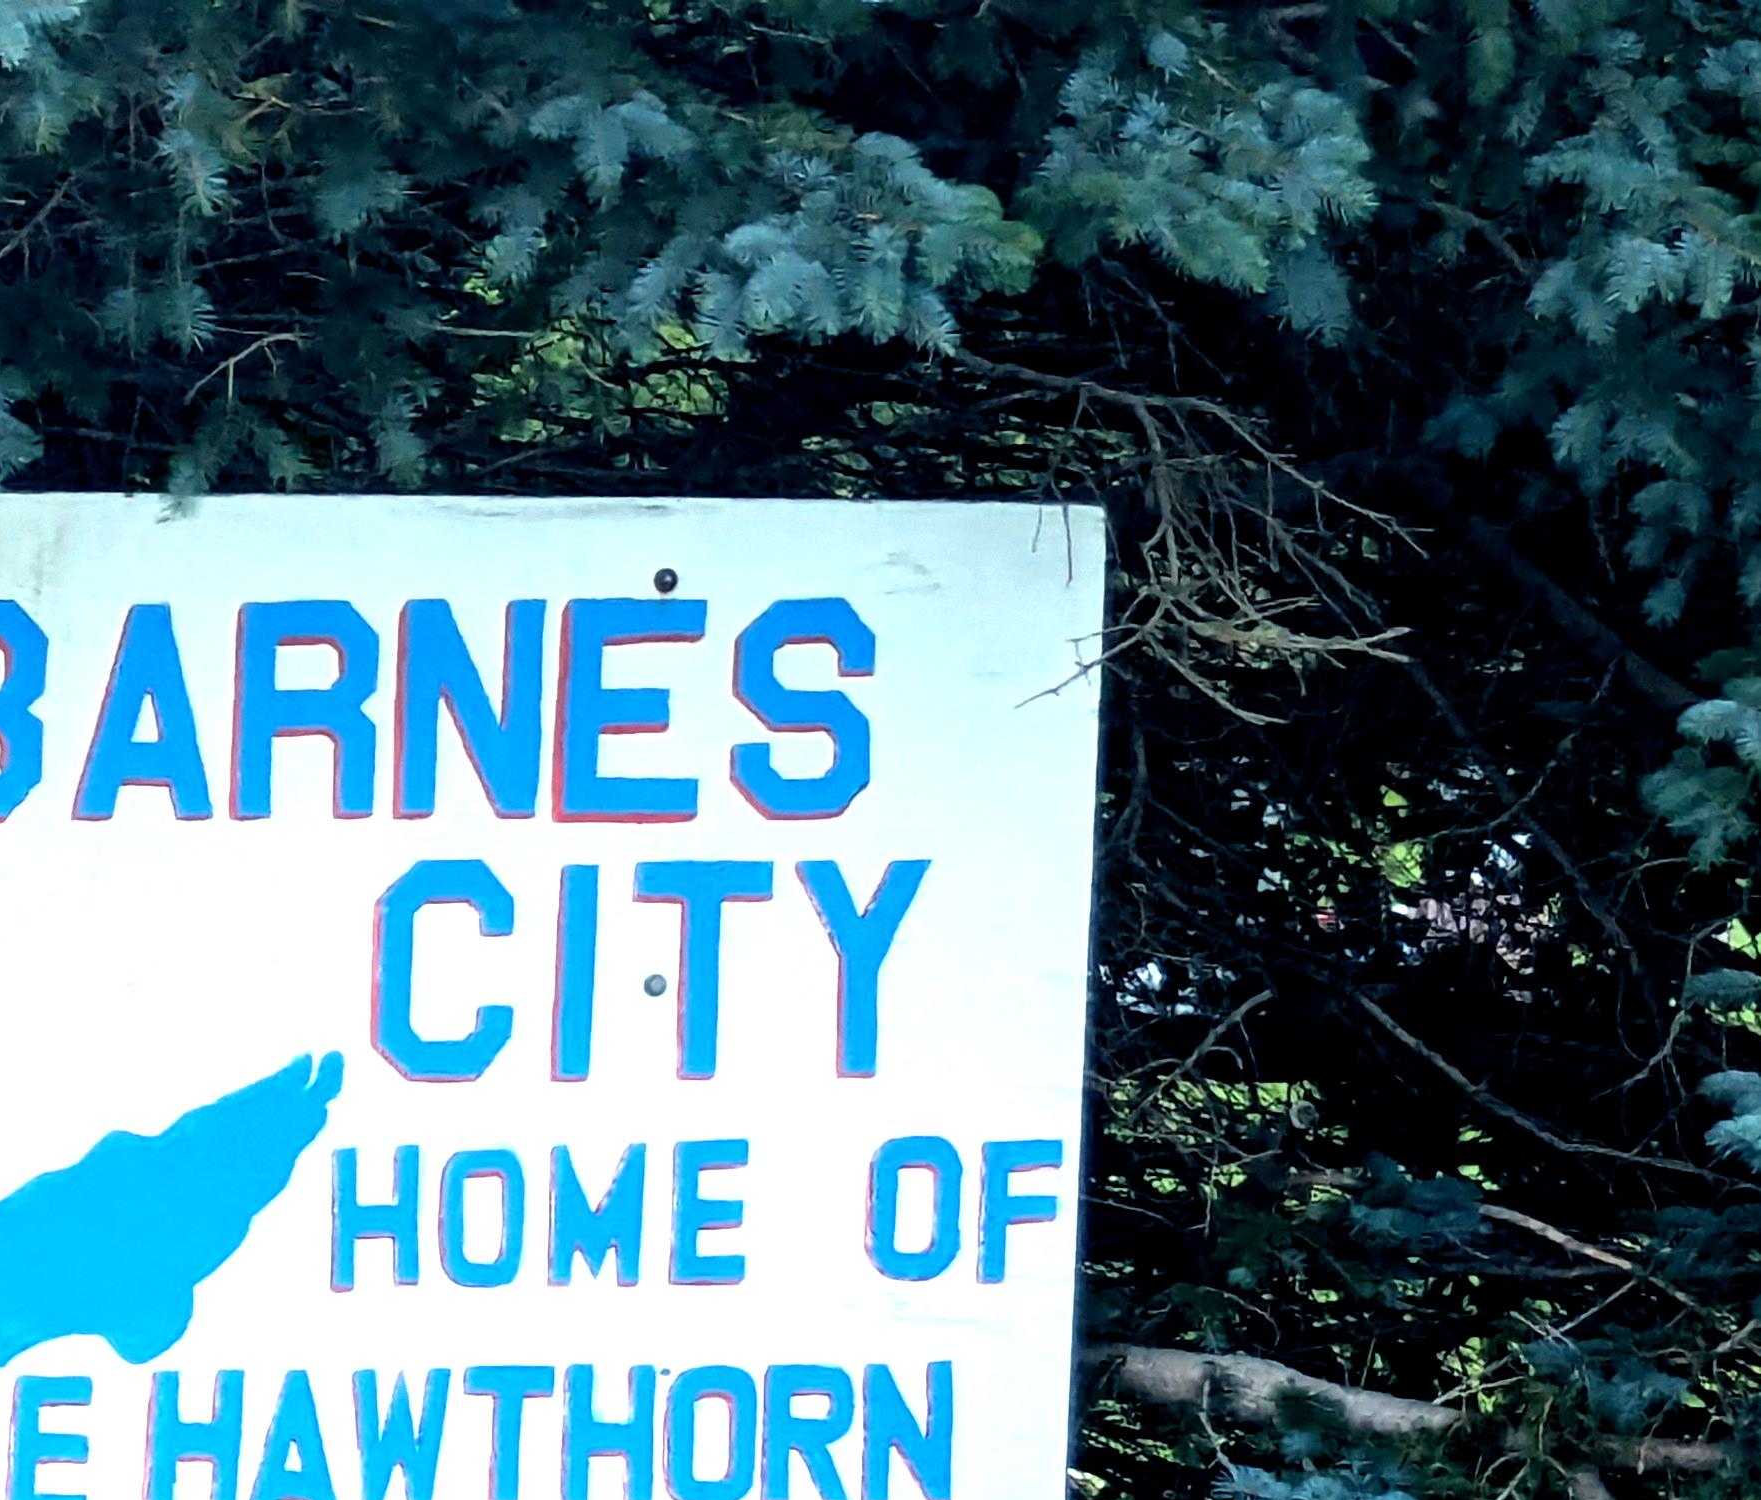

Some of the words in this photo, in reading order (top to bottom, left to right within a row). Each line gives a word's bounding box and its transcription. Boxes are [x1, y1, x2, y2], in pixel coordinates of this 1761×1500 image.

[370, 859, 933, 1082] CITY
[329, 1137, 750, 1293] HOME
[864, 1135, 1063, 1286] OF
